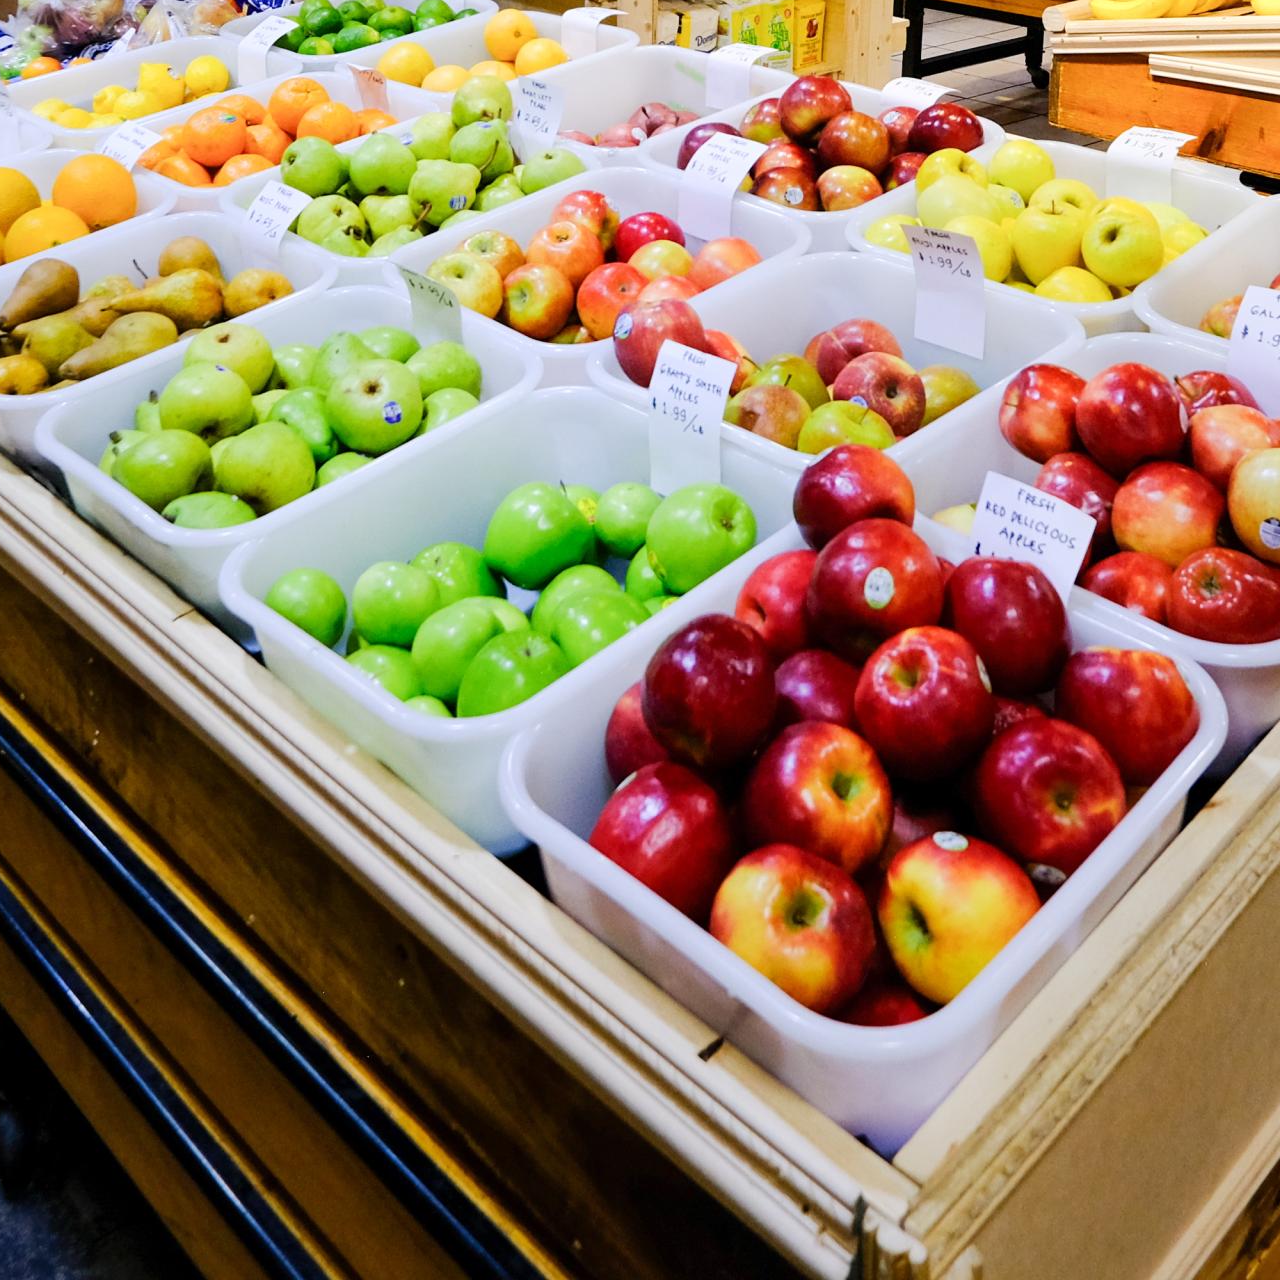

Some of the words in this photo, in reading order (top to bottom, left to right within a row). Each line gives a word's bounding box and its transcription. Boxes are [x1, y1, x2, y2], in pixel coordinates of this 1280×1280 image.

[695, 378, 722, 397] SMITH
[1017, 488, 1056, 512] FRESH
[985, 500, 1006, 517] RED
[1011, 511, 1077, 549] DELICIOUS
[998, 526, 1047, 555] APPLES
